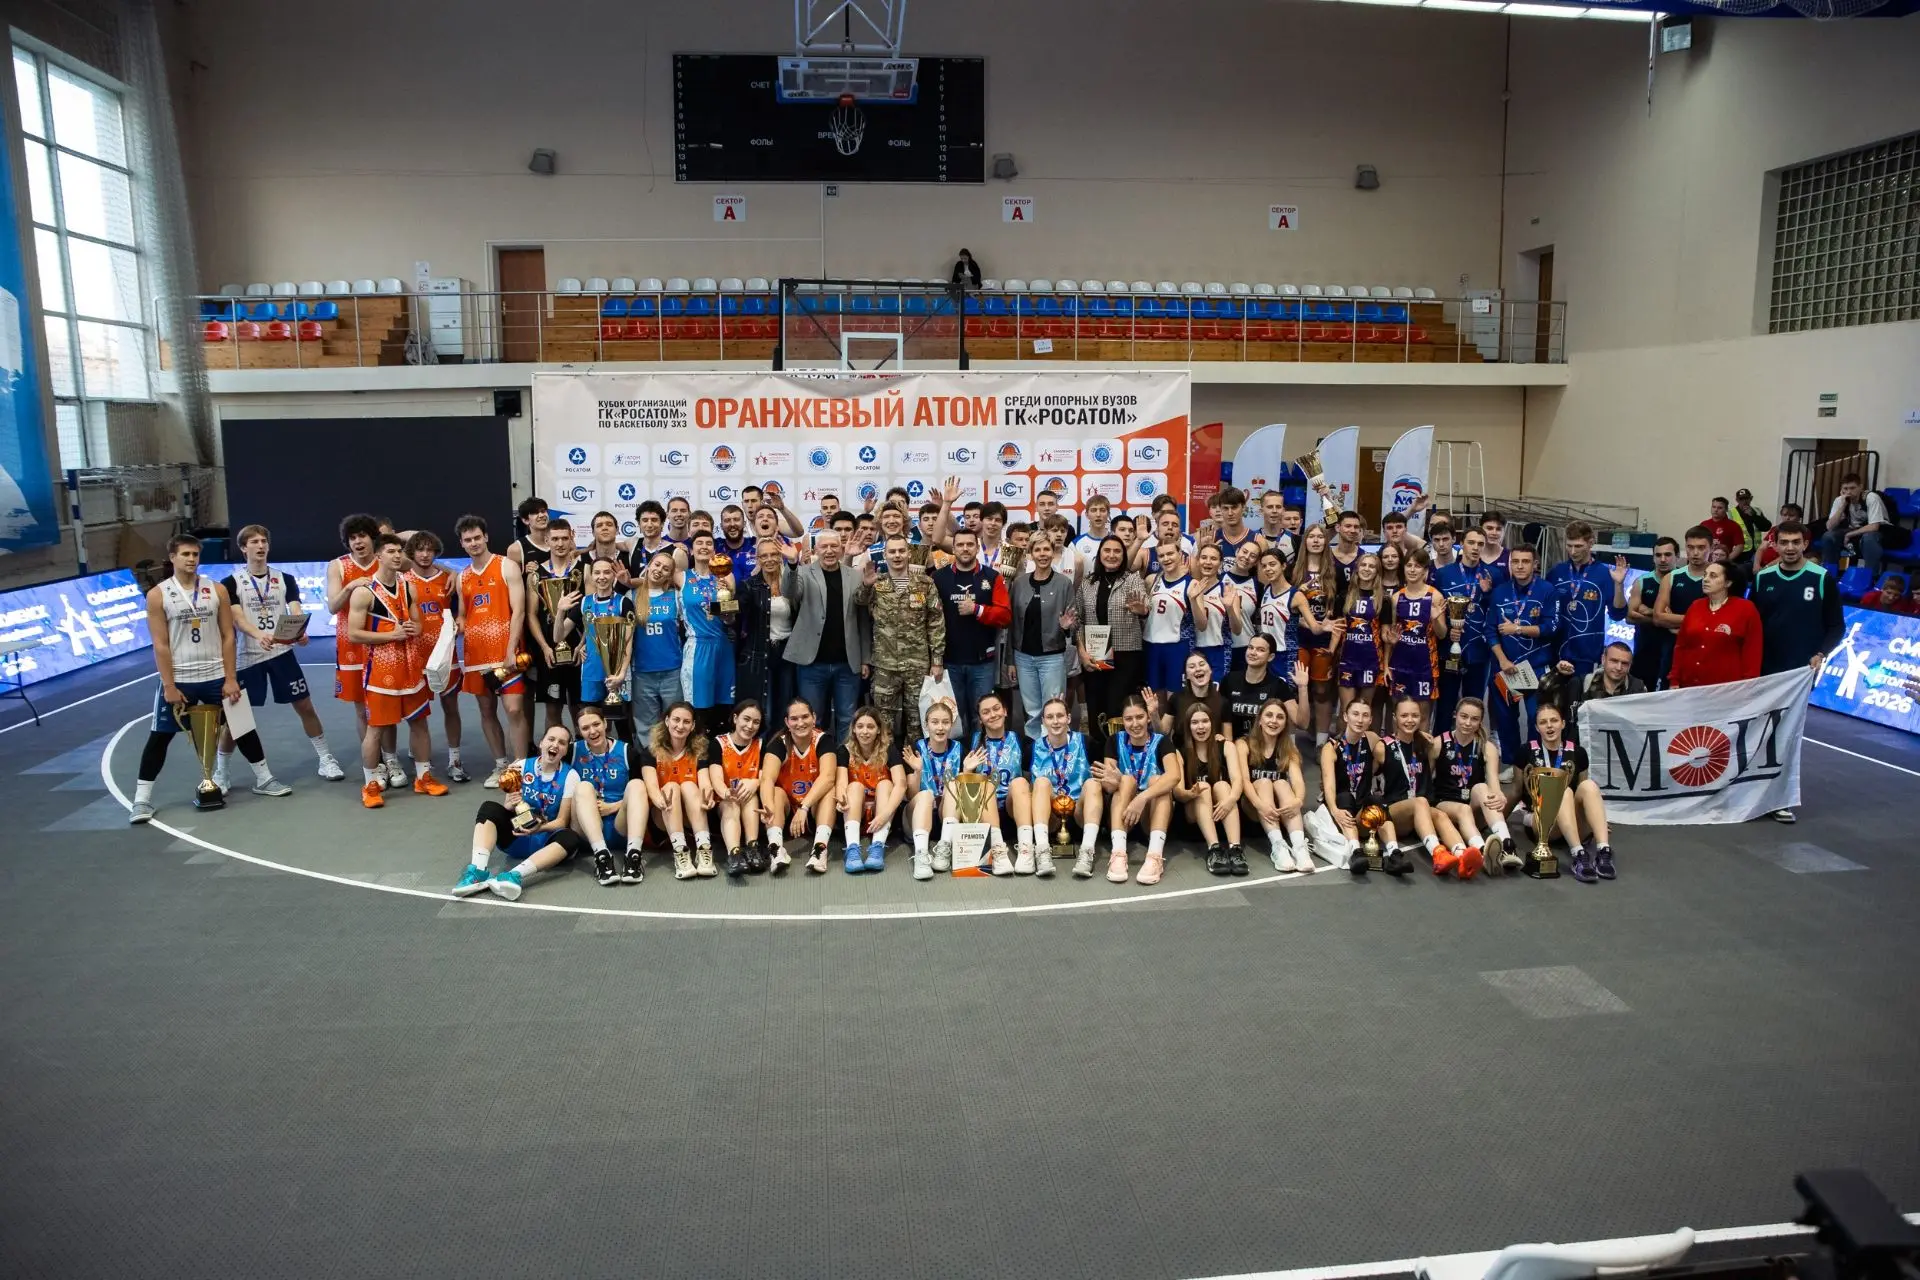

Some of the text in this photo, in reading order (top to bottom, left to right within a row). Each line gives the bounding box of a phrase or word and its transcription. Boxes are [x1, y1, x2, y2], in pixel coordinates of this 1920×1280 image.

[750, 81, 770, 89] СЧЕТ
[749, 138, 774, 146] ФОЛЫ
[887, 139, 911, 147] ФОЛЫ
[598, 398, 687, 409] КУБОК ОРГАНИЗАЦИЙ
[695, 389, 998, 428] ОРАНЖЕВЫЙ АТОМ
[1004, 395, 1138, 408] СРЕДИ ОПОРНЫХ ВУЗОВ
[598, 408, 687, 419] ГК«РОСАТОМ»
[1004, 408, 1138, 426] ГК«РОСАТОМ»
[598, 420, 611, 428] ПО
[613, 420, 668, 429] БАСКЕТБОЛУ
[473, 592, 491, 607] 31
[1803, 586, 1815, 601] 6
[1157, 600, 1167, 614] 5
[1355, 600, 1368, 614] 16
[1408, 602, 1421, 617] 13
[257, 616, 275, 630] 35
[1262, 610, 1274, 626] 13
[191, 628, 201, 644] 8
[646, 622, 663, 636] 66
[1346, 633, 1373, 642] ЛИСЫ
[1363, 670, 1374, 683] 16
[290, 679, 307, 696] 35
[1418, 682, 1430, 696] 13
[1863, 688, 1913, 713] 2026
